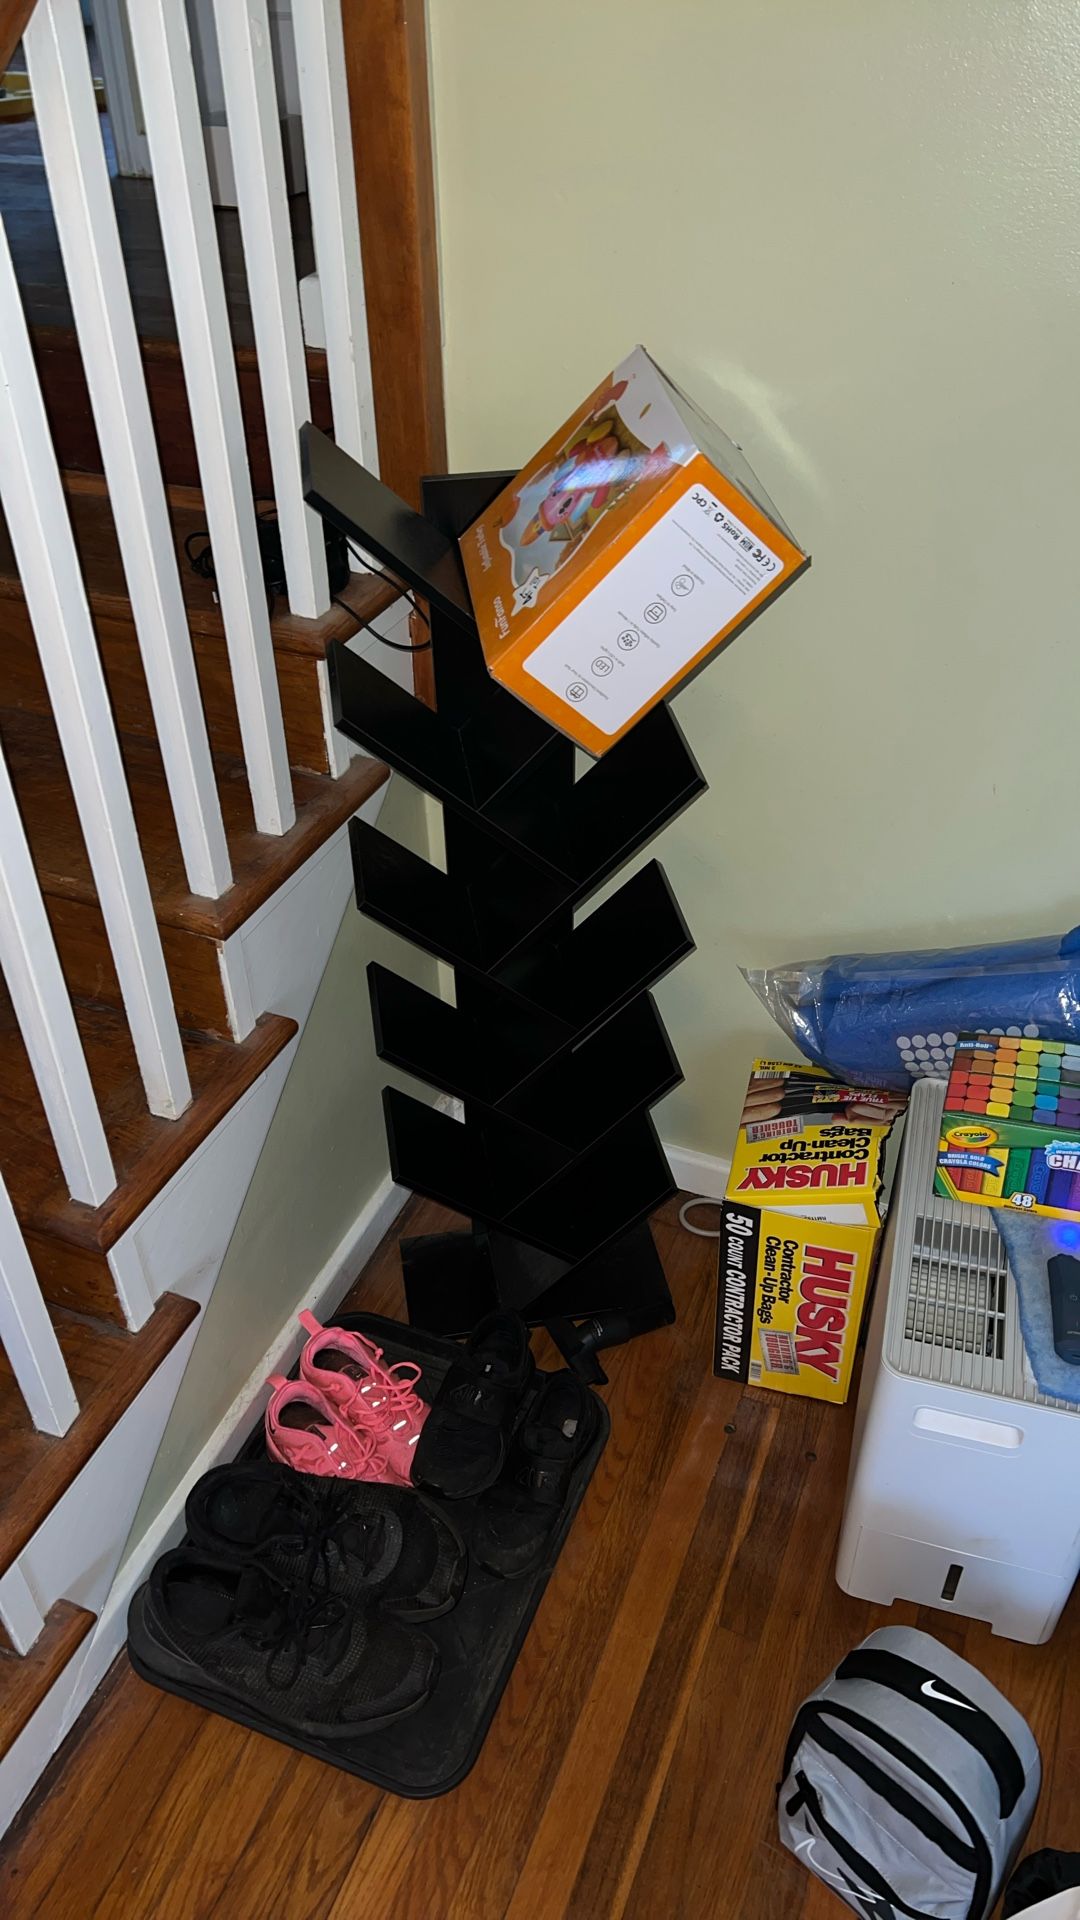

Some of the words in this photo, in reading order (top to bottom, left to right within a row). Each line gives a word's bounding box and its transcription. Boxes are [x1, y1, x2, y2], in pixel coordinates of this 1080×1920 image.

[721, 522, 741, 541] RoHS
[780, 1137, 871, 1151] Clean-Up
[819, 1125, 872, 1138] Bags
[953, 1130, 989, 1138] Crayola
[760, 1149, 869, 1163] Contractor
[968, 1160, 992, 1169] COLORS
[736, 1163, 867, 1191] HUSKY
[1011, 1194, 1033, 1207] 48
[725, 1212, 753, 1237] 50
[727, 1236, 745, 1268] COUNT
[759, 1235, 781, 1293] Clean-Up
[778, 1239, 799, 1304] Contractor
[723, 1269, 748, 1342] CONTRACTOR
[756, 1294, 776, 1324] Bags
[795, 1245, 855, 1379] HUSKY
[721, 1343, 741, 1374] PACK
